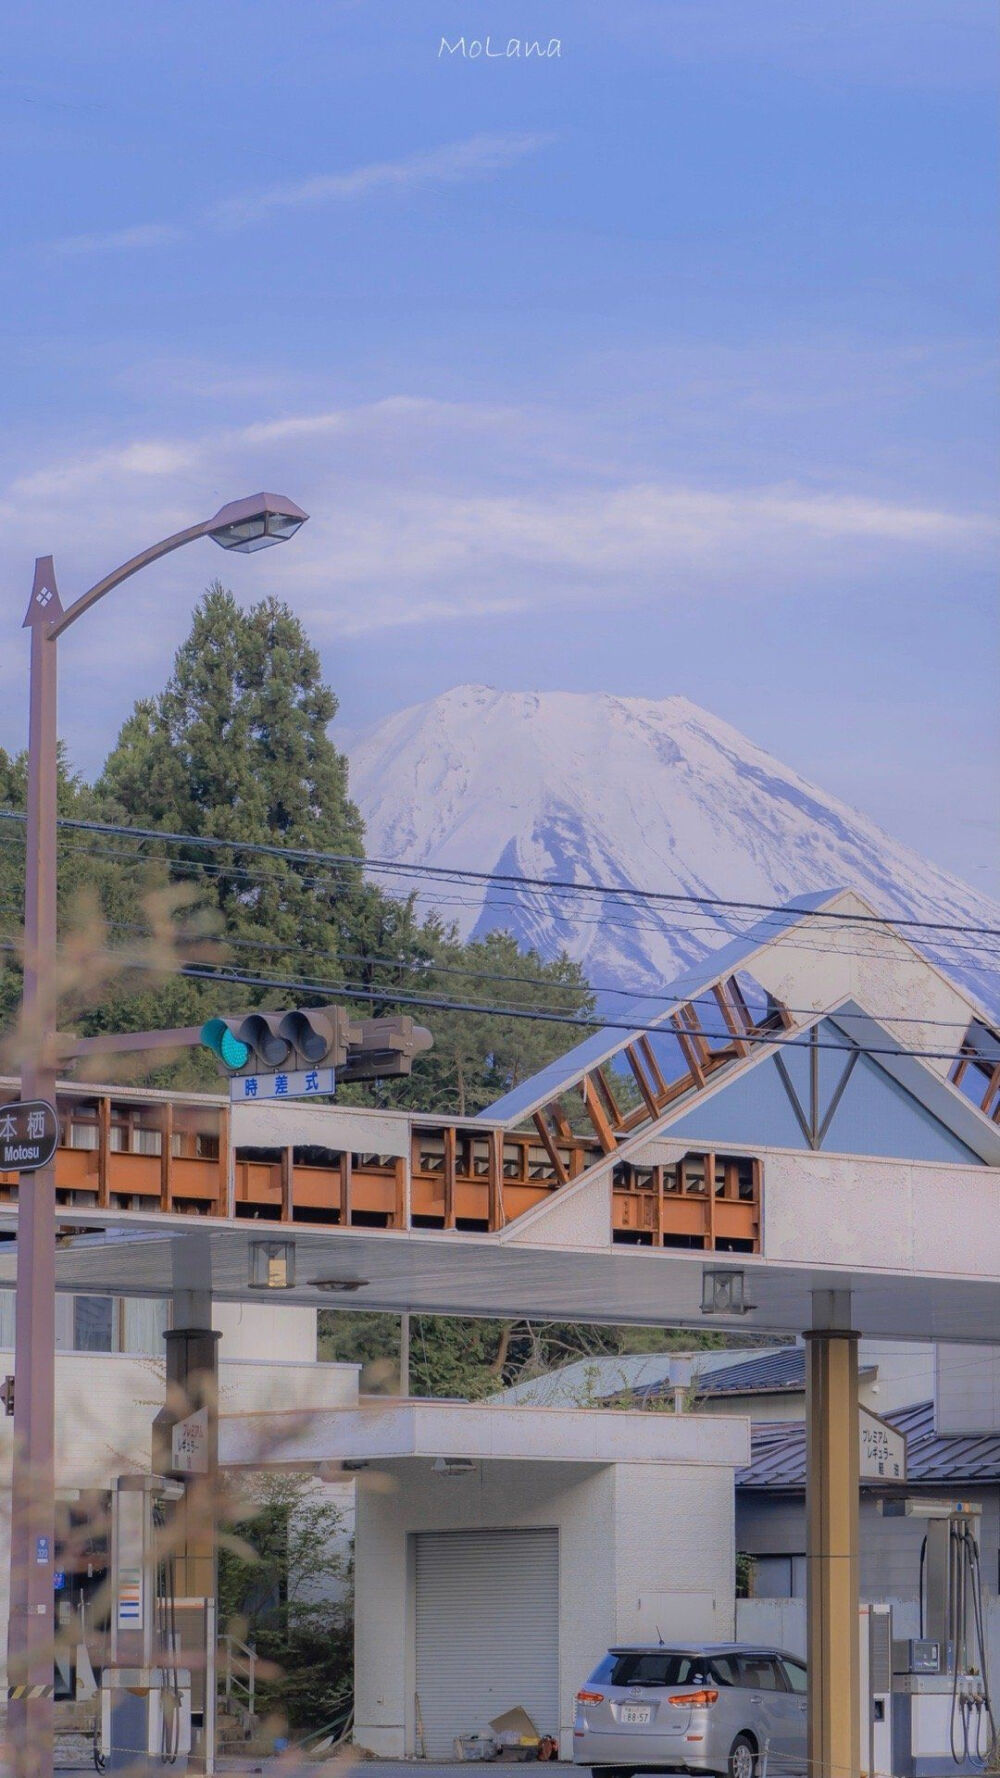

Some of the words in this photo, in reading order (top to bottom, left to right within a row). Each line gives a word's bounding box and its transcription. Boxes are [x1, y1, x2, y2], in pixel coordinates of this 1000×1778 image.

[244, 1071, 319, 1096] 時差式
[0, 1110, 45, 1142] 本栖
[4, 1145, 40, 1161] Motosu
